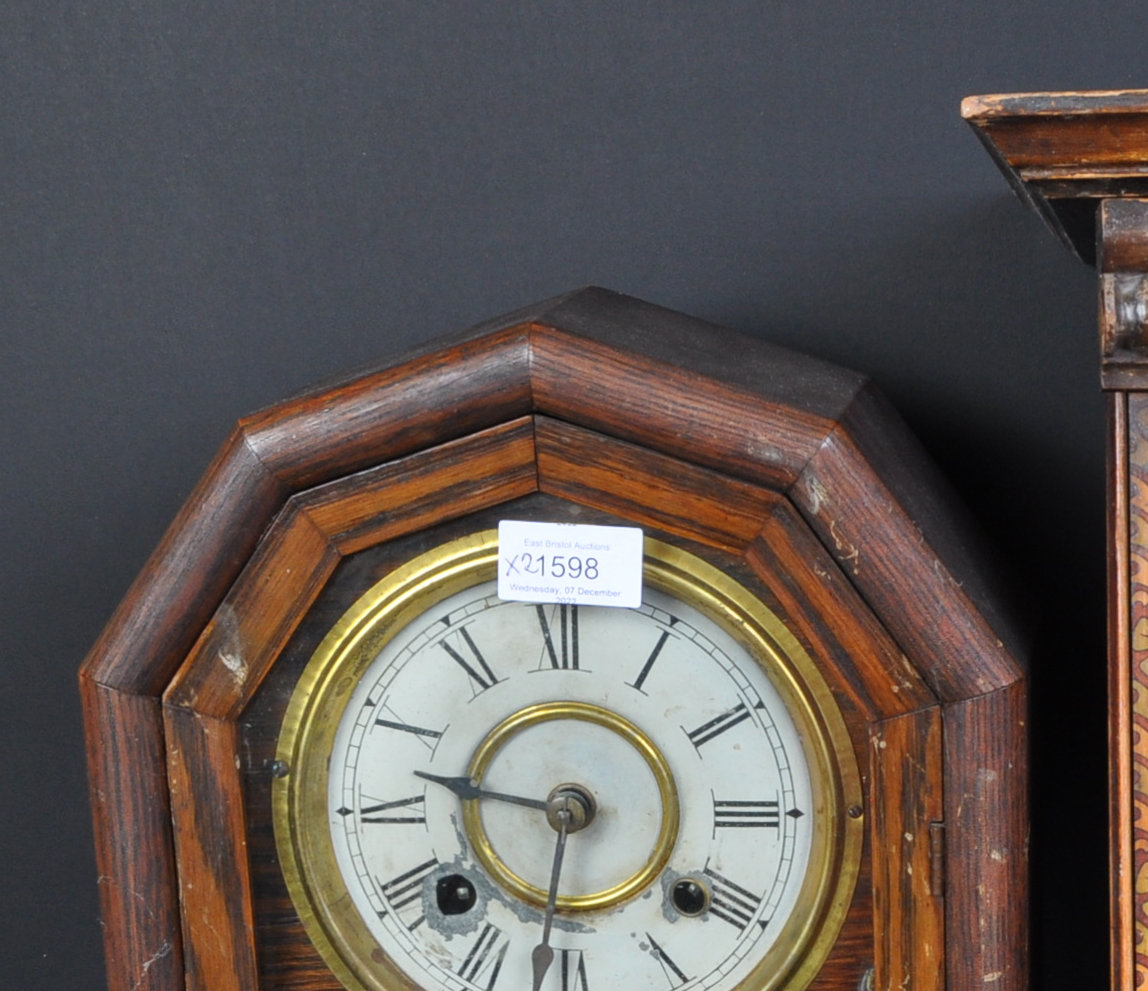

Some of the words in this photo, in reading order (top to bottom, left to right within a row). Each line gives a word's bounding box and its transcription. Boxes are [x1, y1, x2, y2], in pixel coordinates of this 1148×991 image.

[523, 538, 543, 548] East
[545, 539, 572, 549] Bristol
[574, 541, 610, 551] Auctions
[537, 554, 599, 580] 1598
[509, 583, 562, 595] Wednesday,
[564, 586, 575, 594] 07
[577, 587, 621, 597] December
